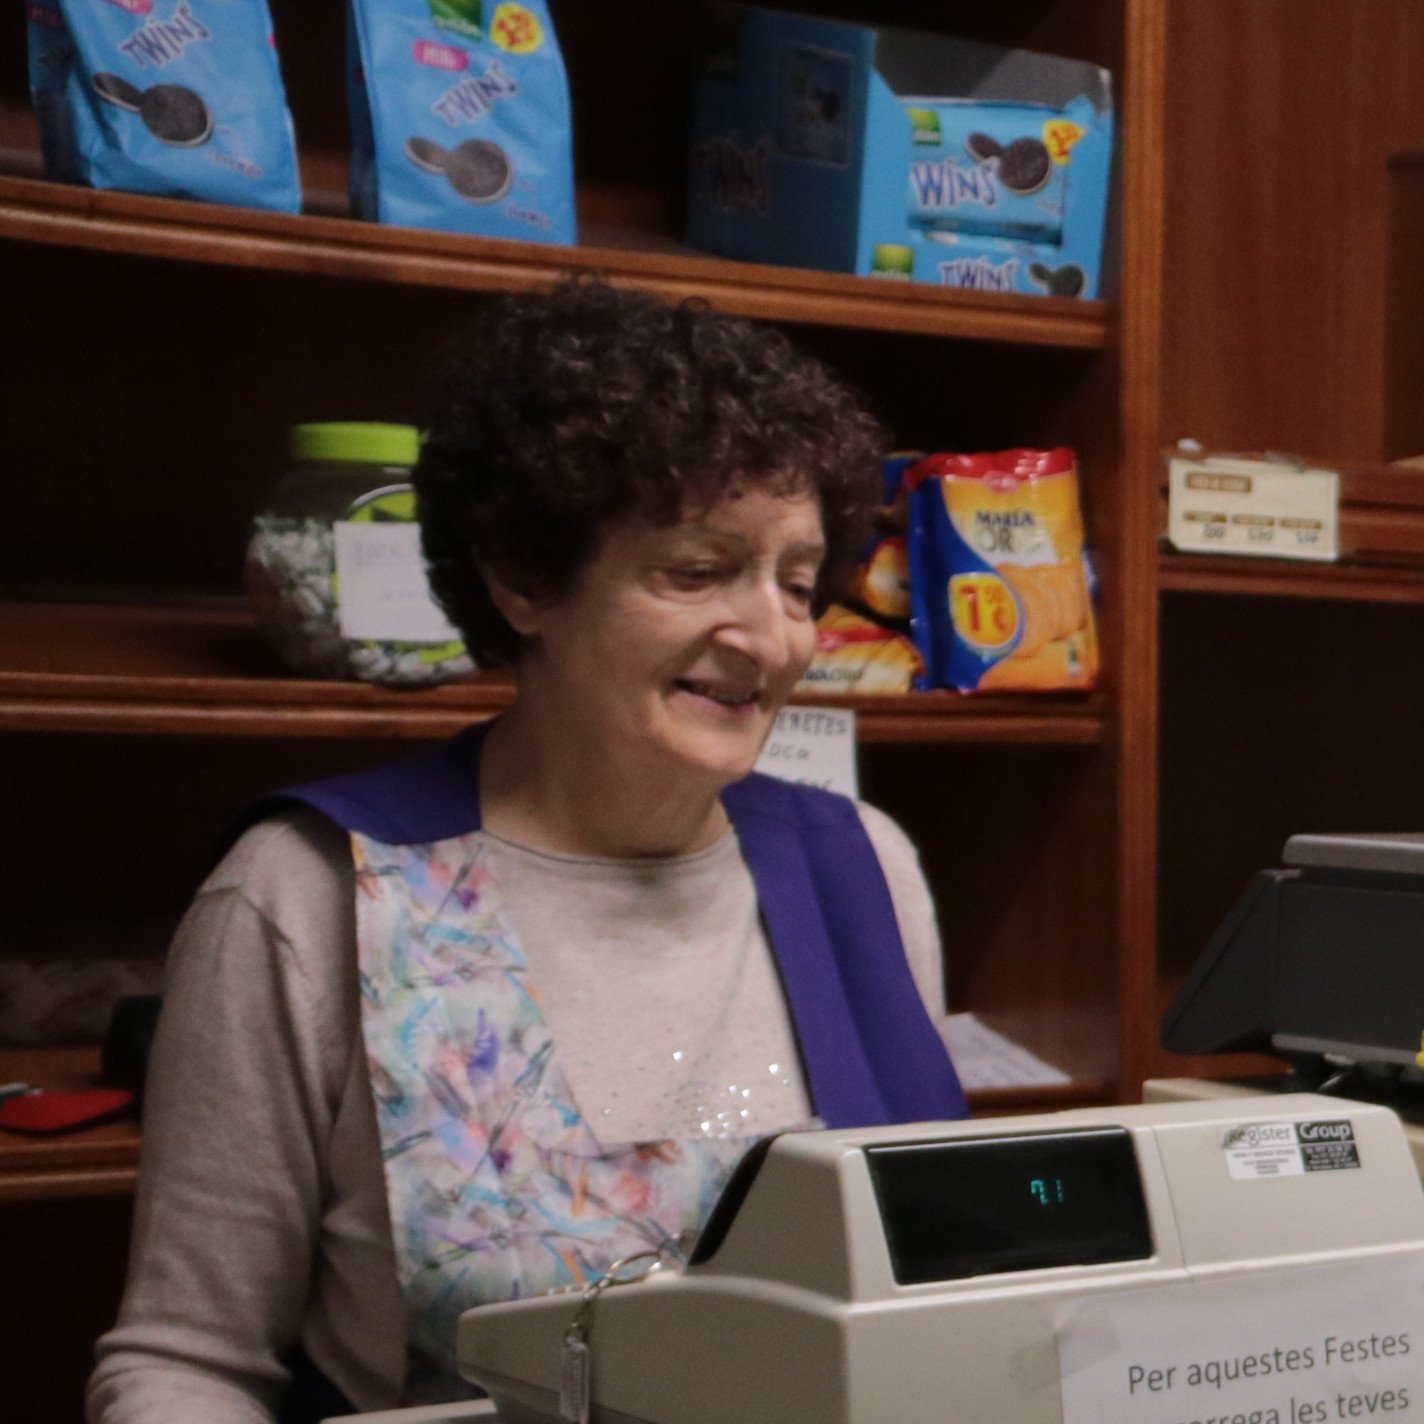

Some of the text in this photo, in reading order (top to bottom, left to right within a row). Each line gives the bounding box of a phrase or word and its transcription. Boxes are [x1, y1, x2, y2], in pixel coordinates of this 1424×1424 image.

[119, 2, 208, 65] TWINS
[433, 60, 520, 125] TWINS
[1299, 1121, 1351, 1140] Group
[1128, 1332, 1410, 1394] Per aquestes Festes
[1337, 1387, 1409, 1419] teves
